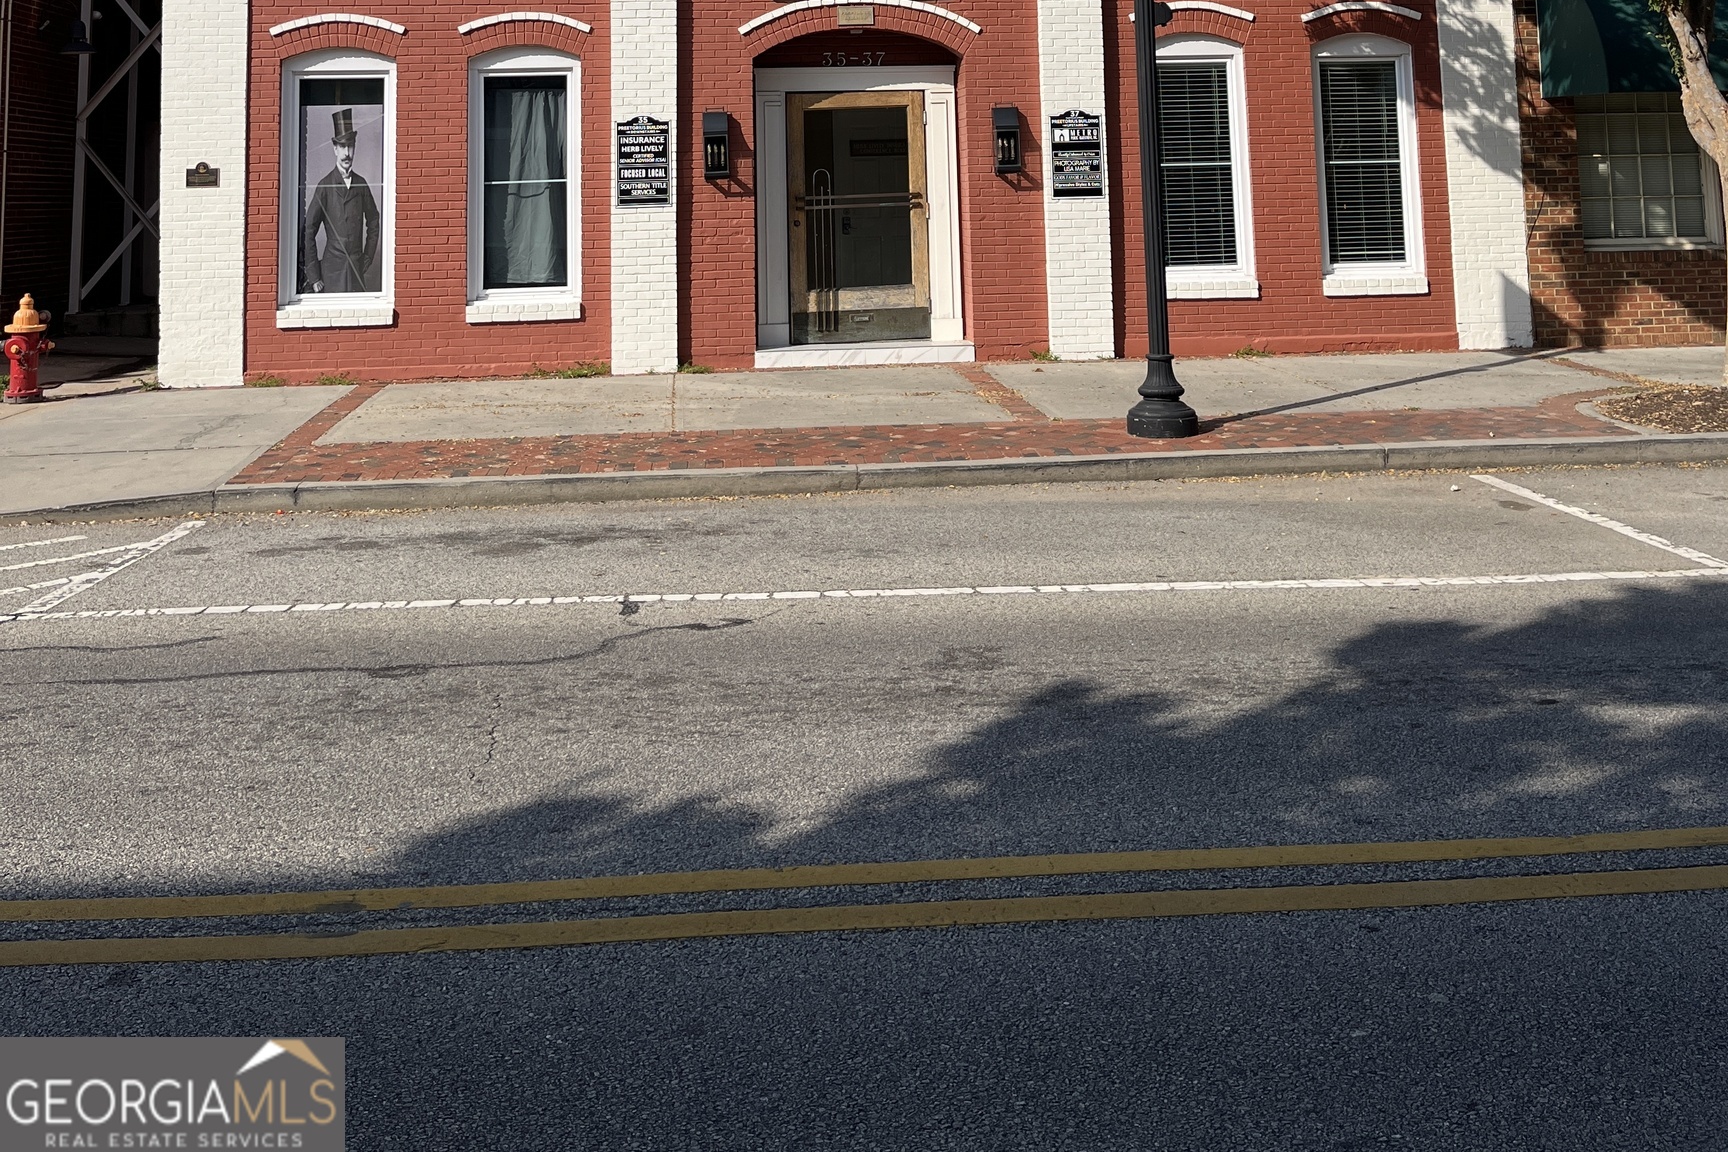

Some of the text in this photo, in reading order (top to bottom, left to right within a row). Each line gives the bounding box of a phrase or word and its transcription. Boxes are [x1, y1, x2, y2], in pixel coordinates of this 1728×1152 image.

[822, 51, 886, 67] 35-37
[620, 136, 666, 144] INSURANCE
[620, 168, 666, 178] FOCUSED LOCAL
